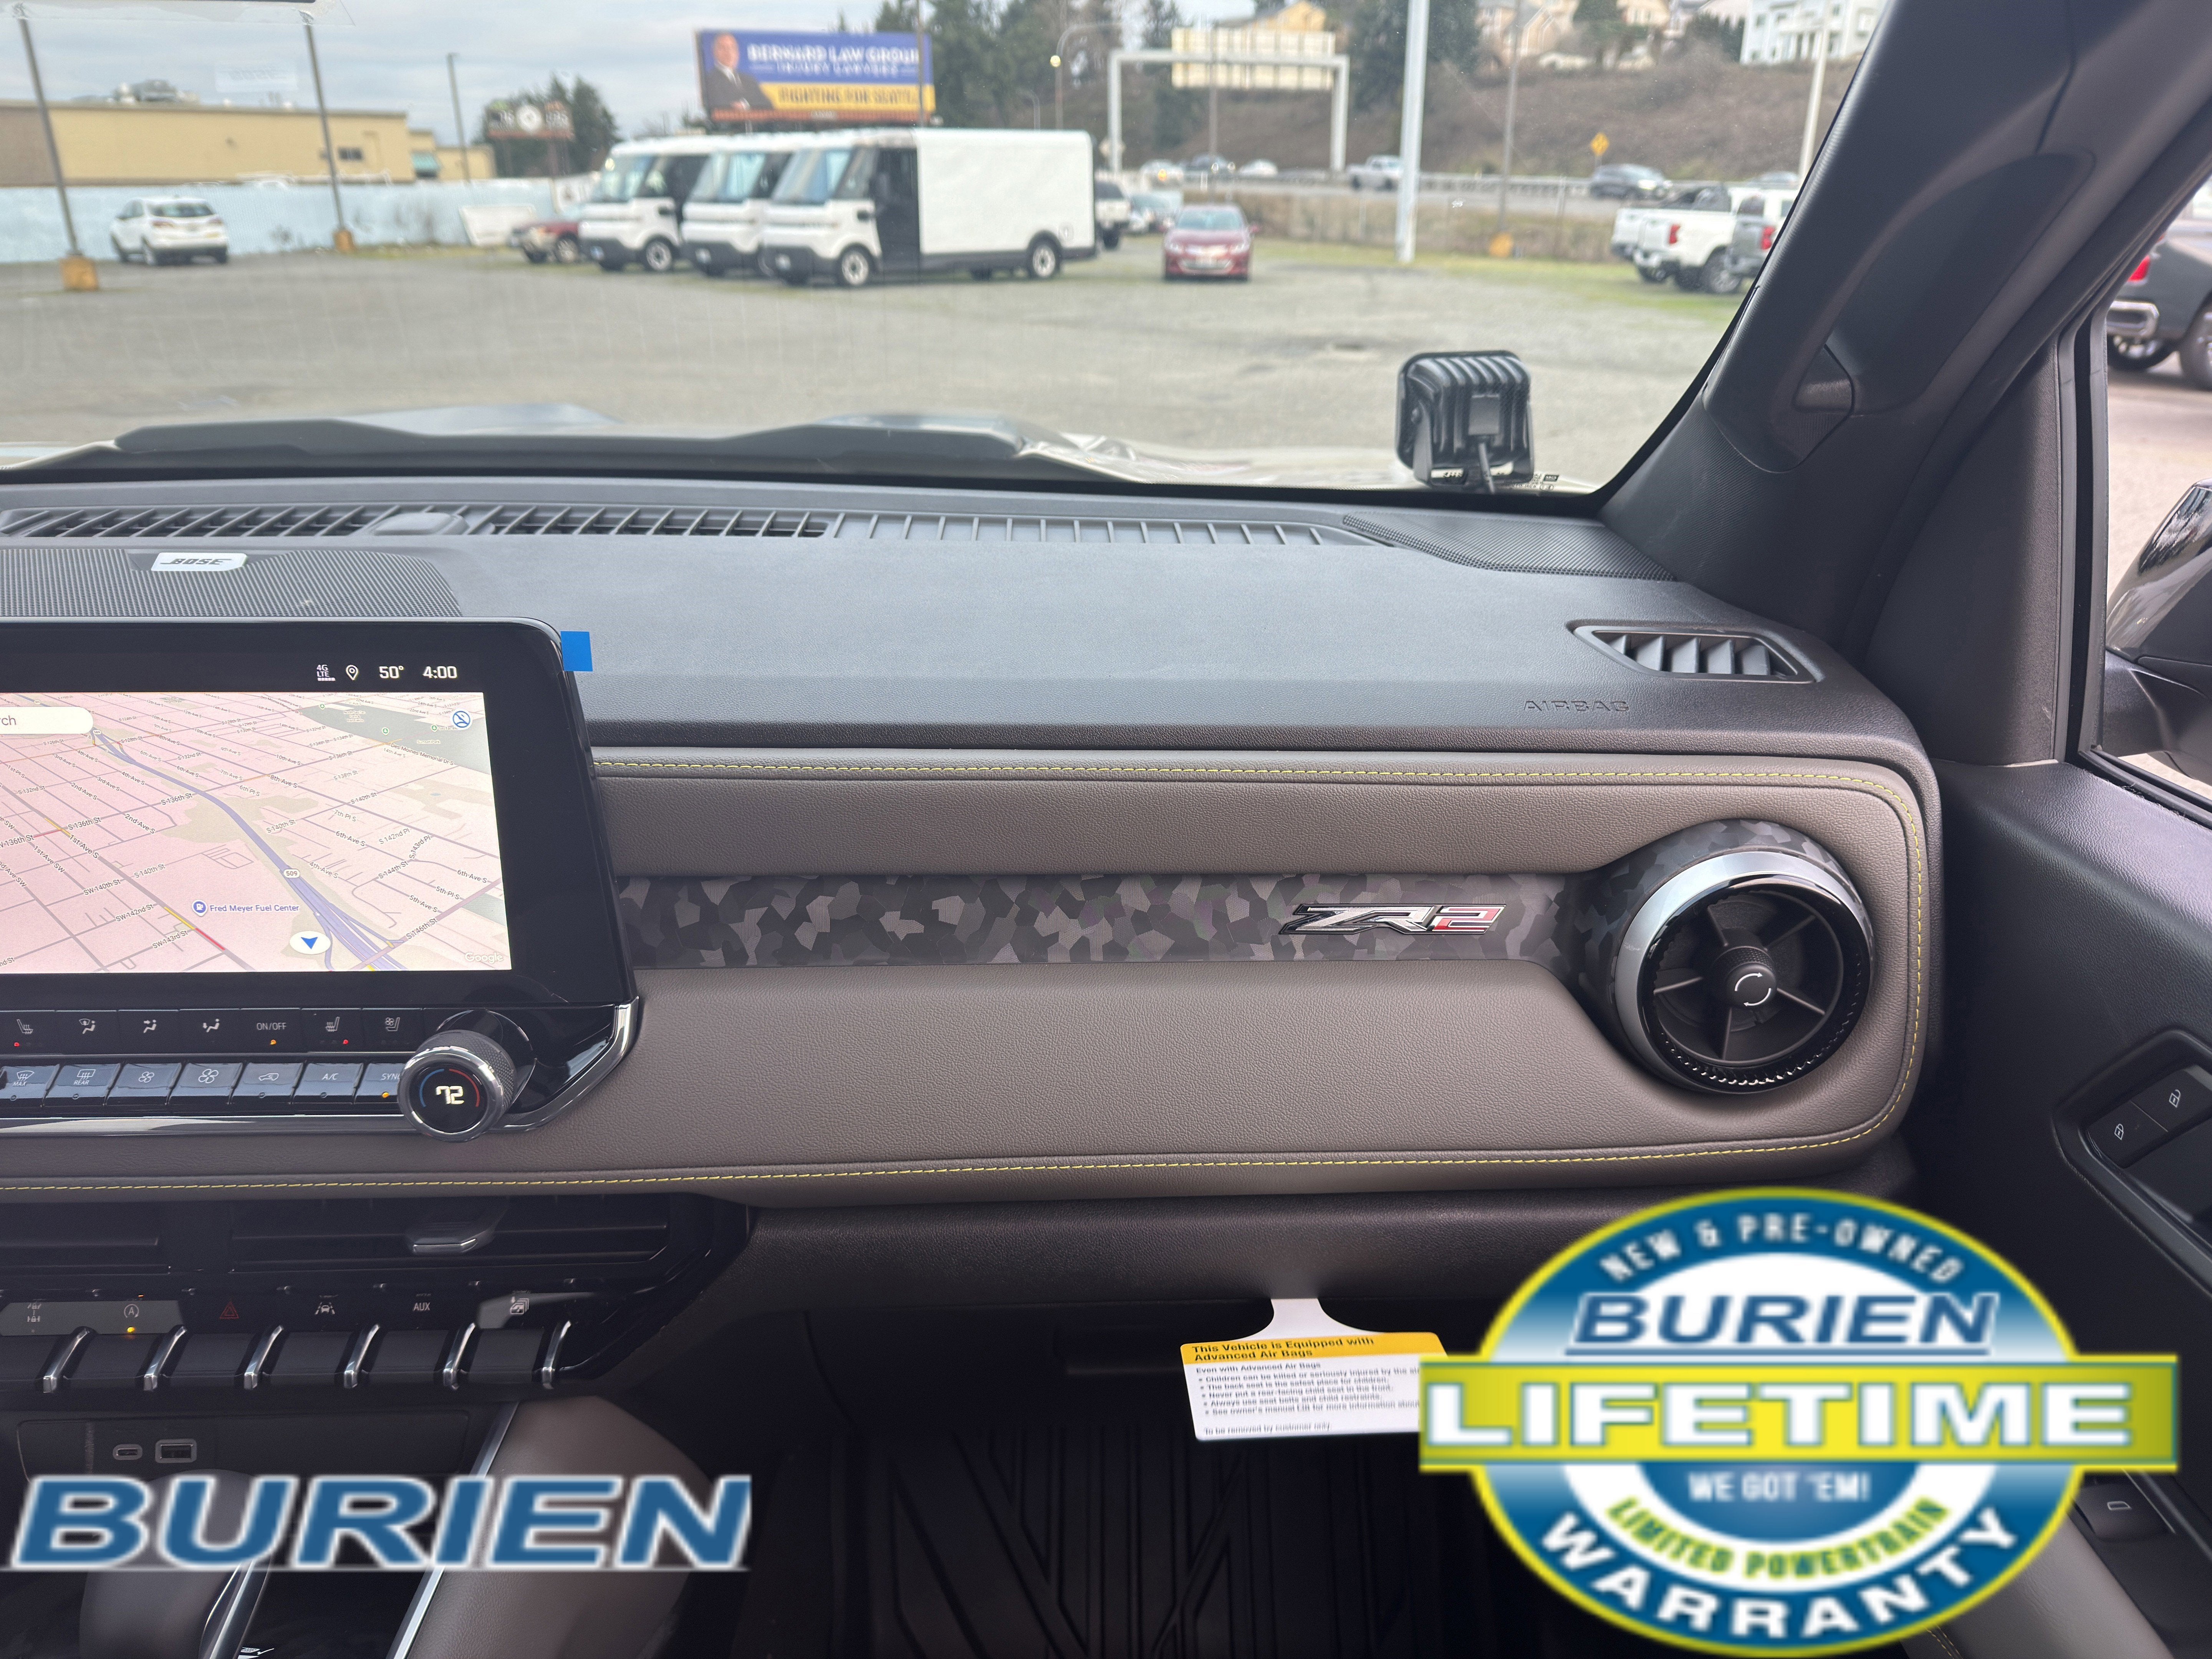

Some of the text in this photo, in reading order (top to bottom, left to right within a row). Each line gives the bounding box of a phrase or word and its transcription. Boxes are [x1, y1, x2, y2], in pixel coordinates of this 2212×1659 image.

[379, 666, 404, 678] 50°
[423, 666, 457, 678] 4:00
[1523, 701, 1629, 711] AIRBAG
[401, 746, 419, 755] Moines
[420, 752, 442, 762] Memorial
[71, 783, 81, 791] 2nd
[82, 789, 92, 797] Ave
[167, 794, 184, 803] 136th
[75, 820, 92, 828] 136th
[125, 814, 137, 823] 2nd
[137, 821, 150, 831] Ave
[70, 835, 79, 844] 1st
[81, 843, 92, 854] Ave
[34, 846, 65, 872] 1st Ave SW
[141, 867, 157, 876] 140th
[321, 867, 332, 876] Ave
[384, 865, 400, 876] 144th
[95, 882, 112, 891] 140th
[410, 895, 419, 903] 5th
[420, 901, 432, 911] Ave
[127, 907, 146, 917] 142nd
[1279, 903, 1506, 934] ZR2
[412, 923, 429, 936] 146th
[164, 934, 180, 944] 143rd
[465, 952, 503, 963] Google
[436, 1086, 464, 1104] 72
[413, 1303, 430, 1311] AUX
[1222, 1342, 1267, 1351] Vehicle
[1286, 1339, 1343, 1349] Equipped
[1346, 1337, 1374, 1345] with
[1195, 1351, 1255, 1361] Advanced
[1241, 1363, 1282, 1372] Advanced
